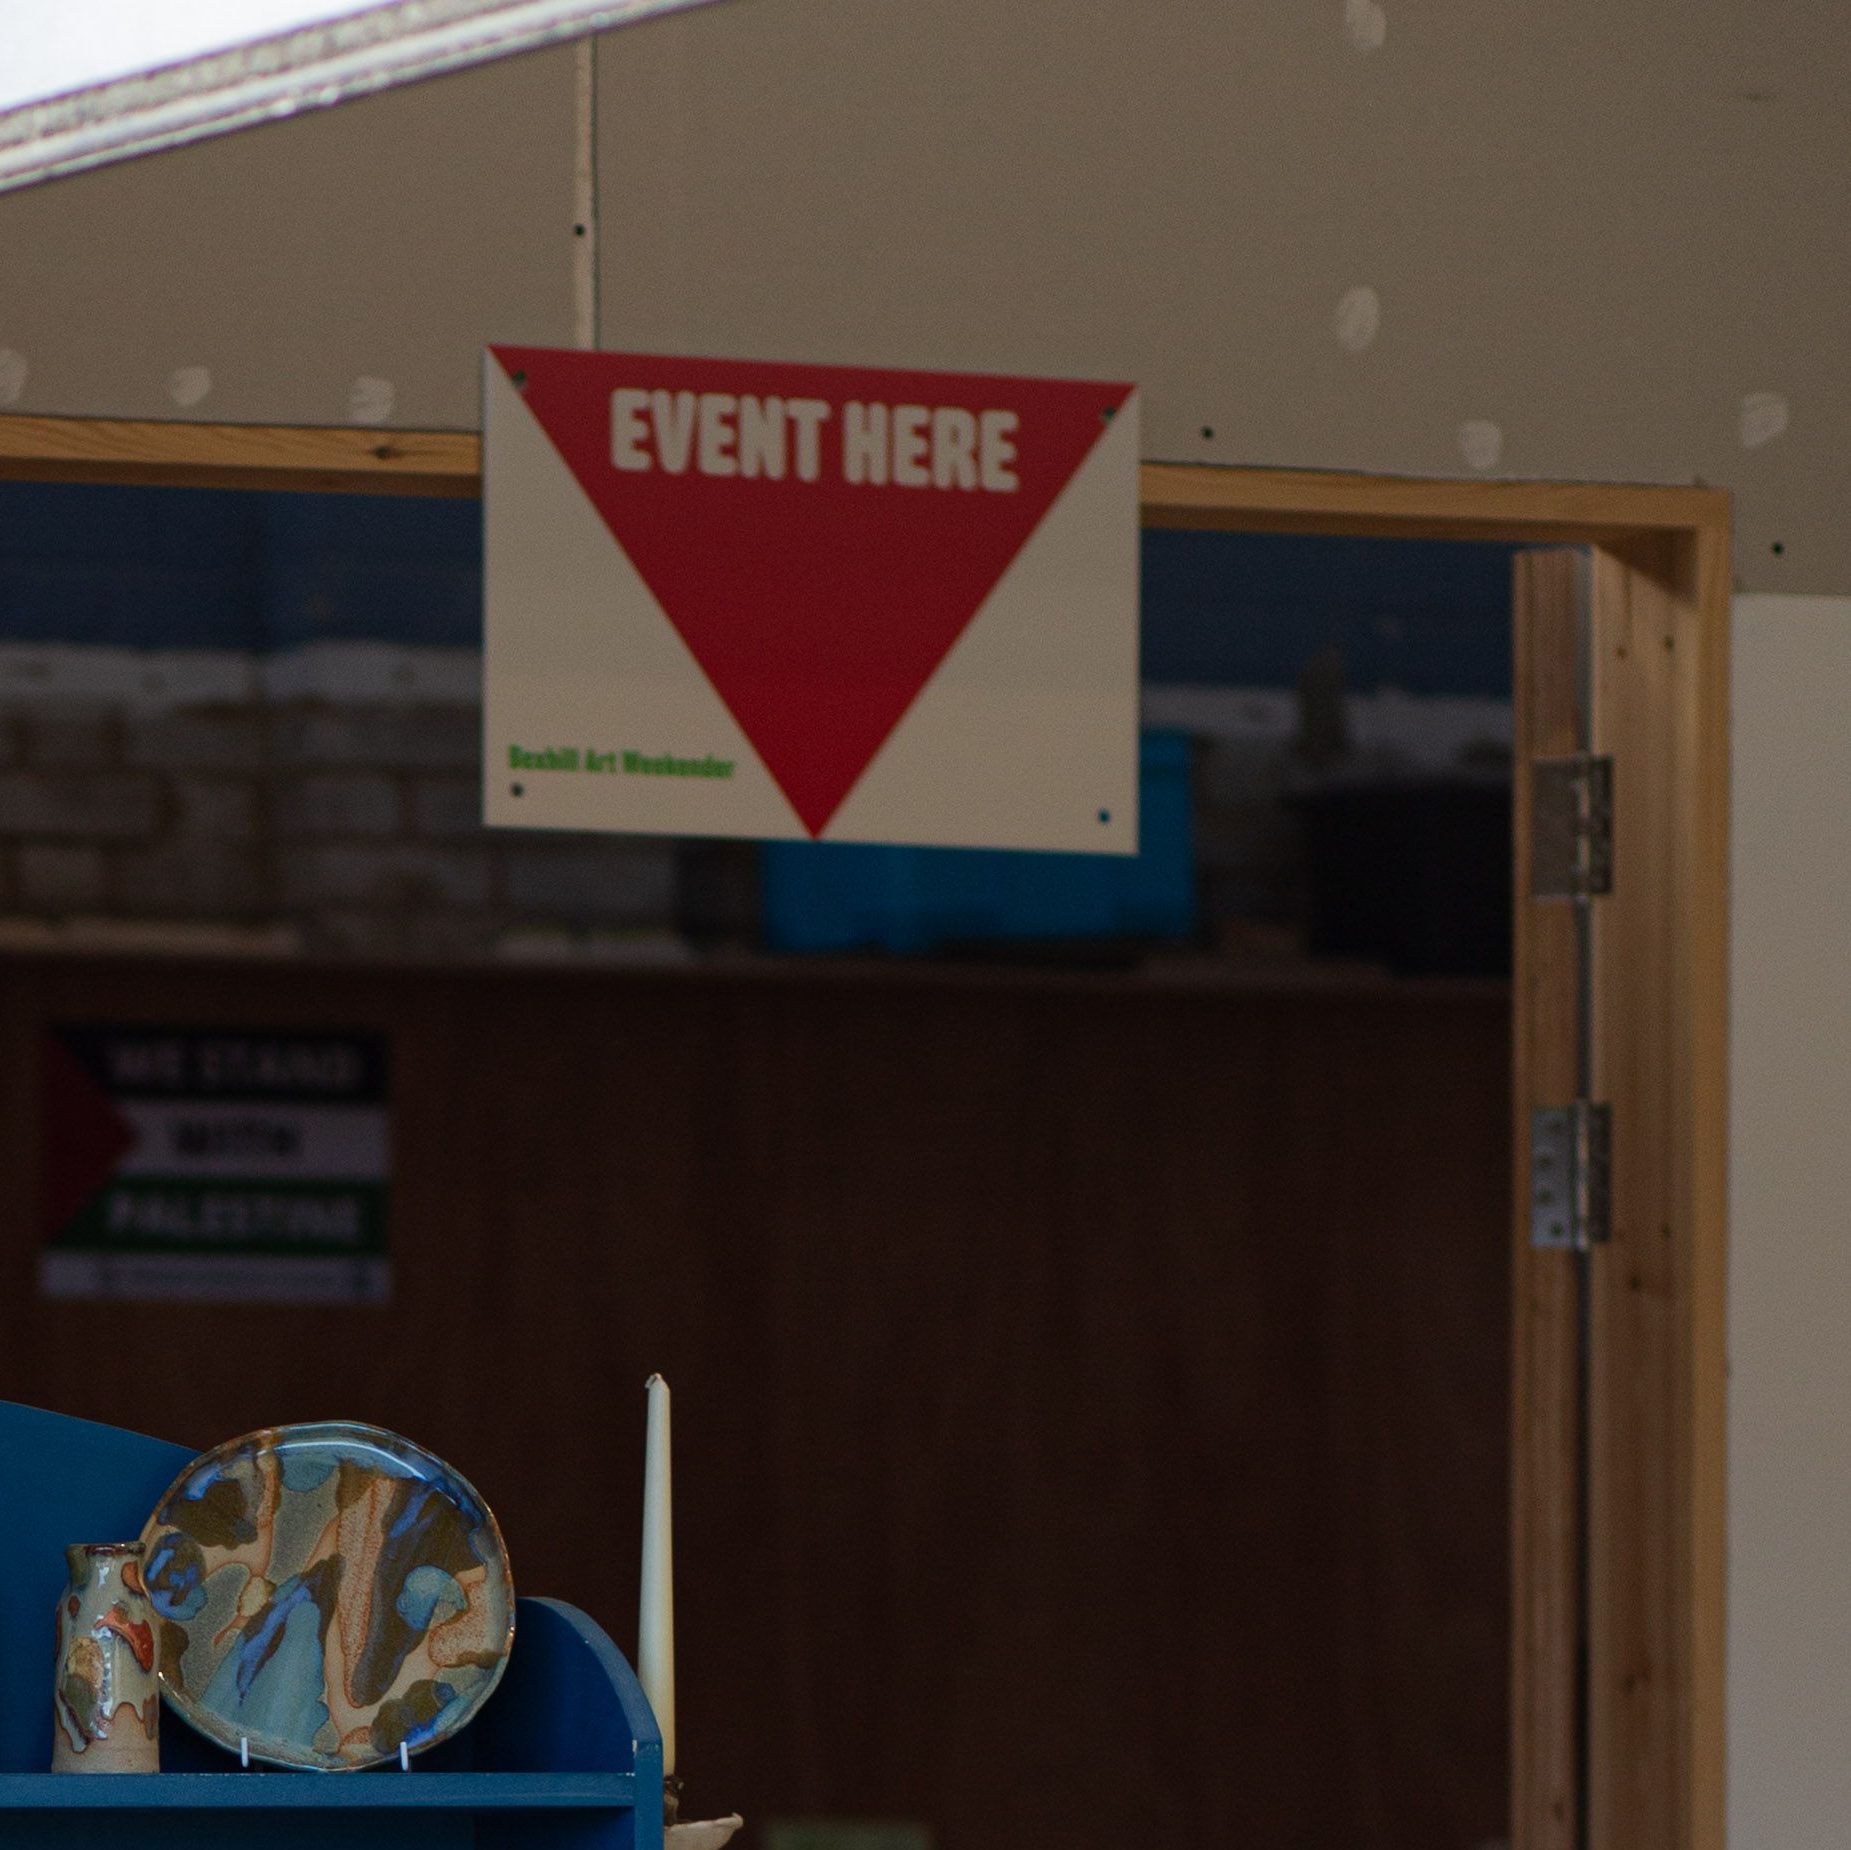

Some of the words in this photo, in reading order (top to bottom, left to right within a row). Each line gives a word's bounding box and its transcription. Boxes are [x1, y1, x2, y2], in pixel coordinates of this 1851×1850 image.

[609, 387, 831, 483] EVENT
[843, 399, 1020, 493] HERE
[508, 744, 580, 773] Bexhill
[584, 747, 618, 775] Art
[622, 748, 736, 779] Weekender
